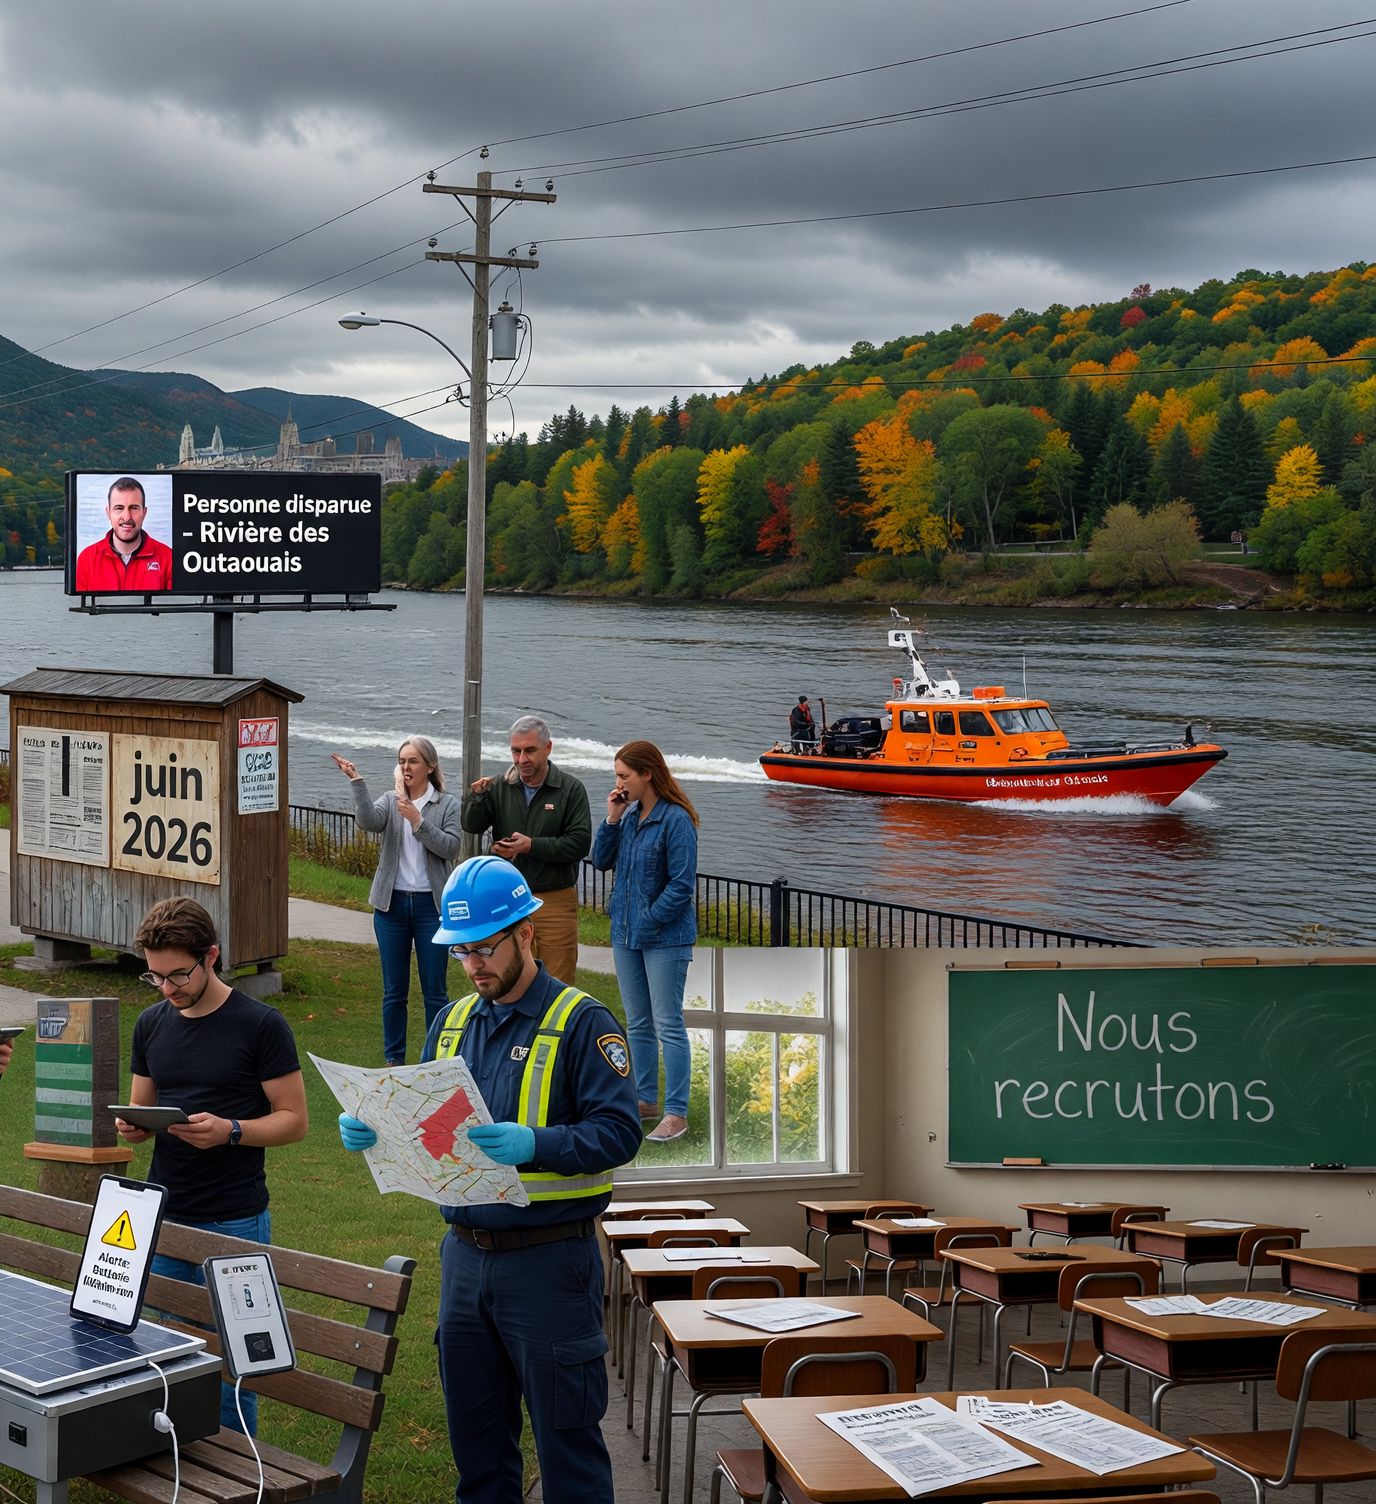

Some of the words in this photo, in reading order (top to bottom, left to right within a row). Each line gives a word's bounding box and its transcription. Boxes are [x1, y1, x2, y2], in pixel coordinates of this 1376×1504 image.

[183, 494, 281, 514] Personne
[285, 493, 372, 518] disparue
[200, 519, 283, 544] Rivière
[289, 519, 330, 544] des
[182, 549, 303, 574] Outaouais
[130, 750, 203, 805] juin
[122, 811, 213, 867] 2026
[1057, 989, 1198, 1054] Nous
[994, 1062, 1274, 1123] recrutons
